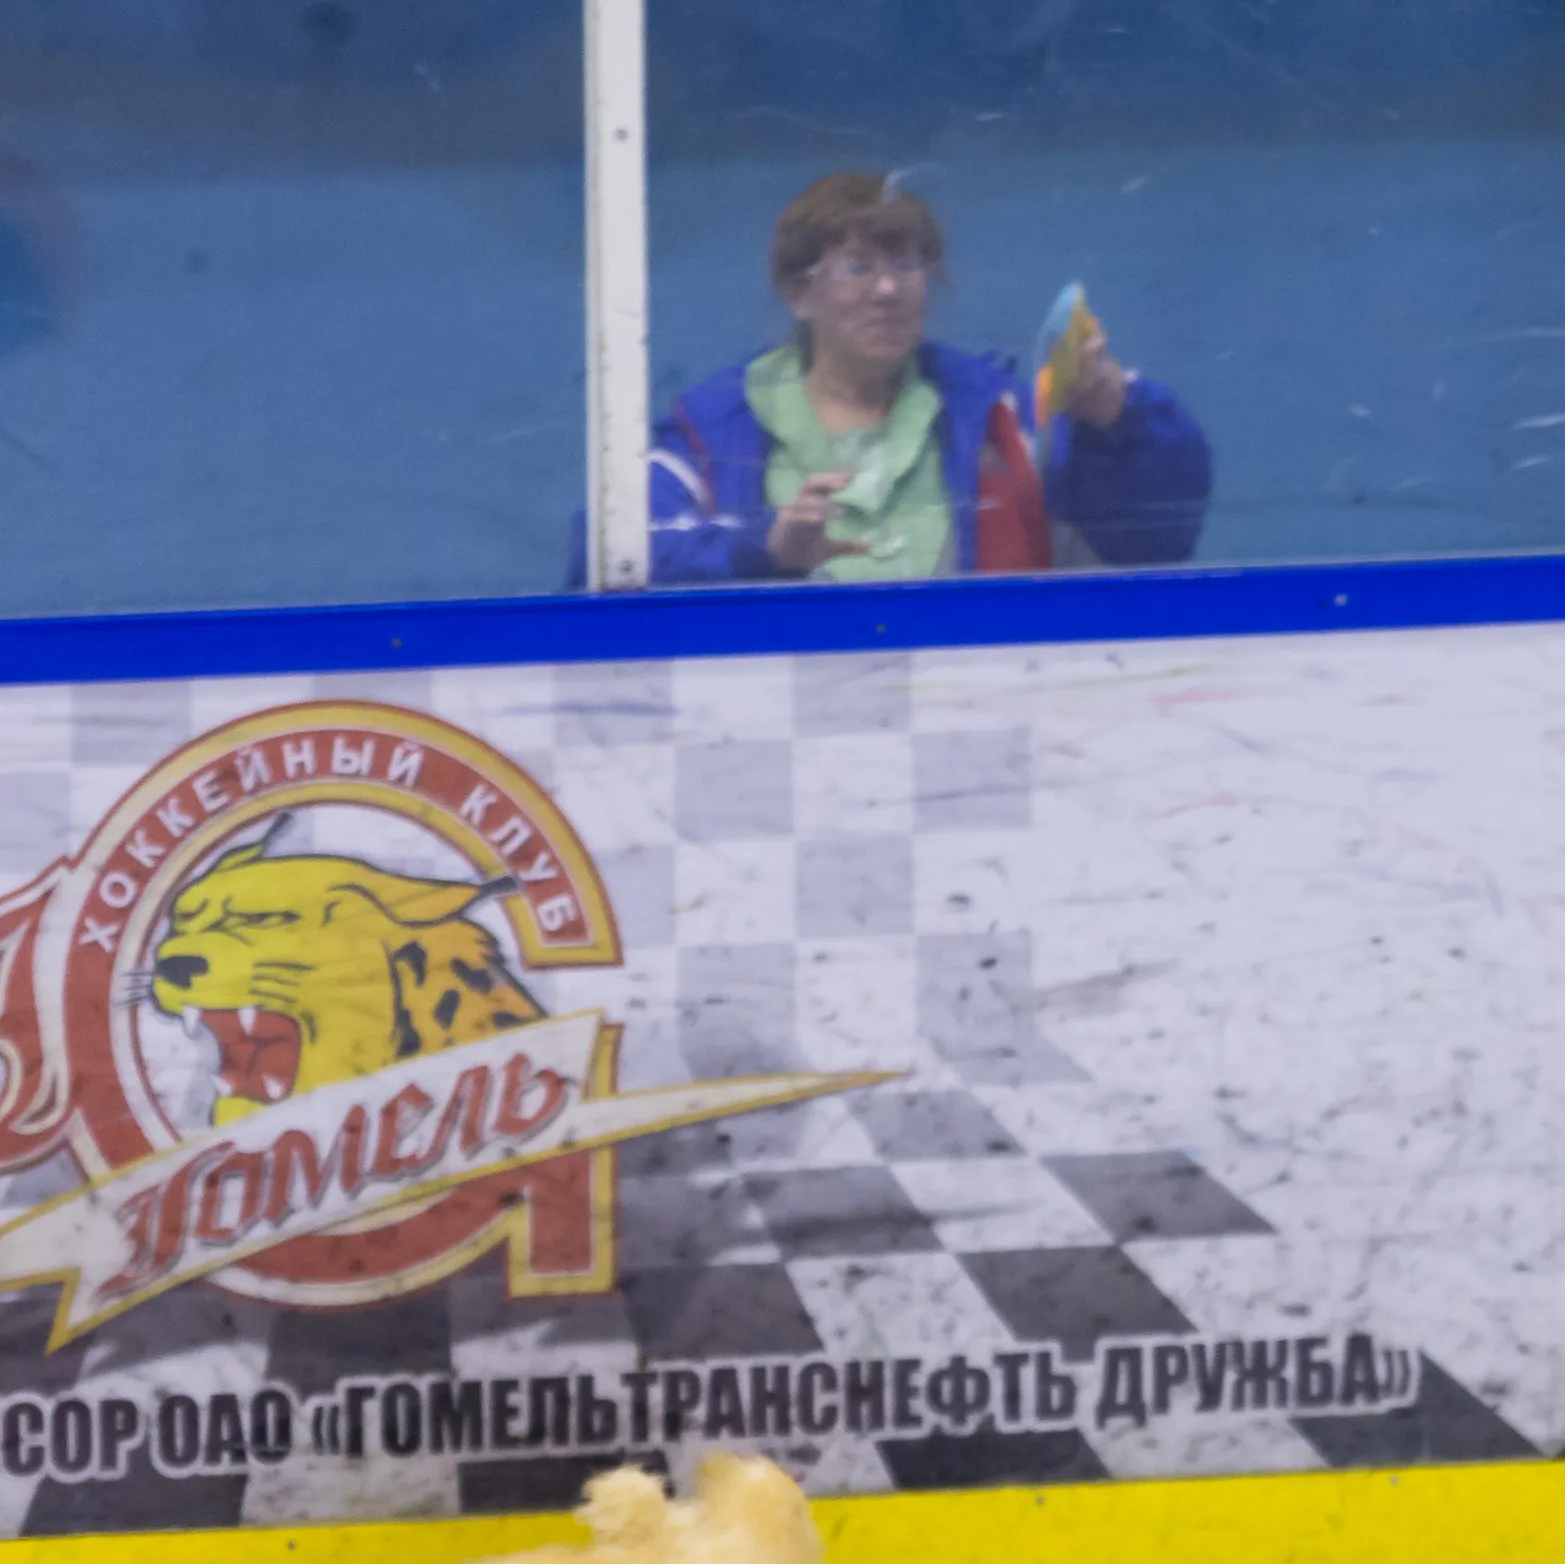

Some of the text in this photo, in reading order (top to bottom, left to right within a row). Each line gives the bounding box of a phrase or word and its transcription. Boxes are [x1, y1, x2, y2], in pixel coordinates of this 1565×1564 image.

[80, 737, 578, 953] ХОККЕЙНЫЙ КЛУБ
[2, 1333, 1414, 1475] СОР ОАО «ГОМЕЛЬТРАНСНЕФТЬ ДРУЖБА»
